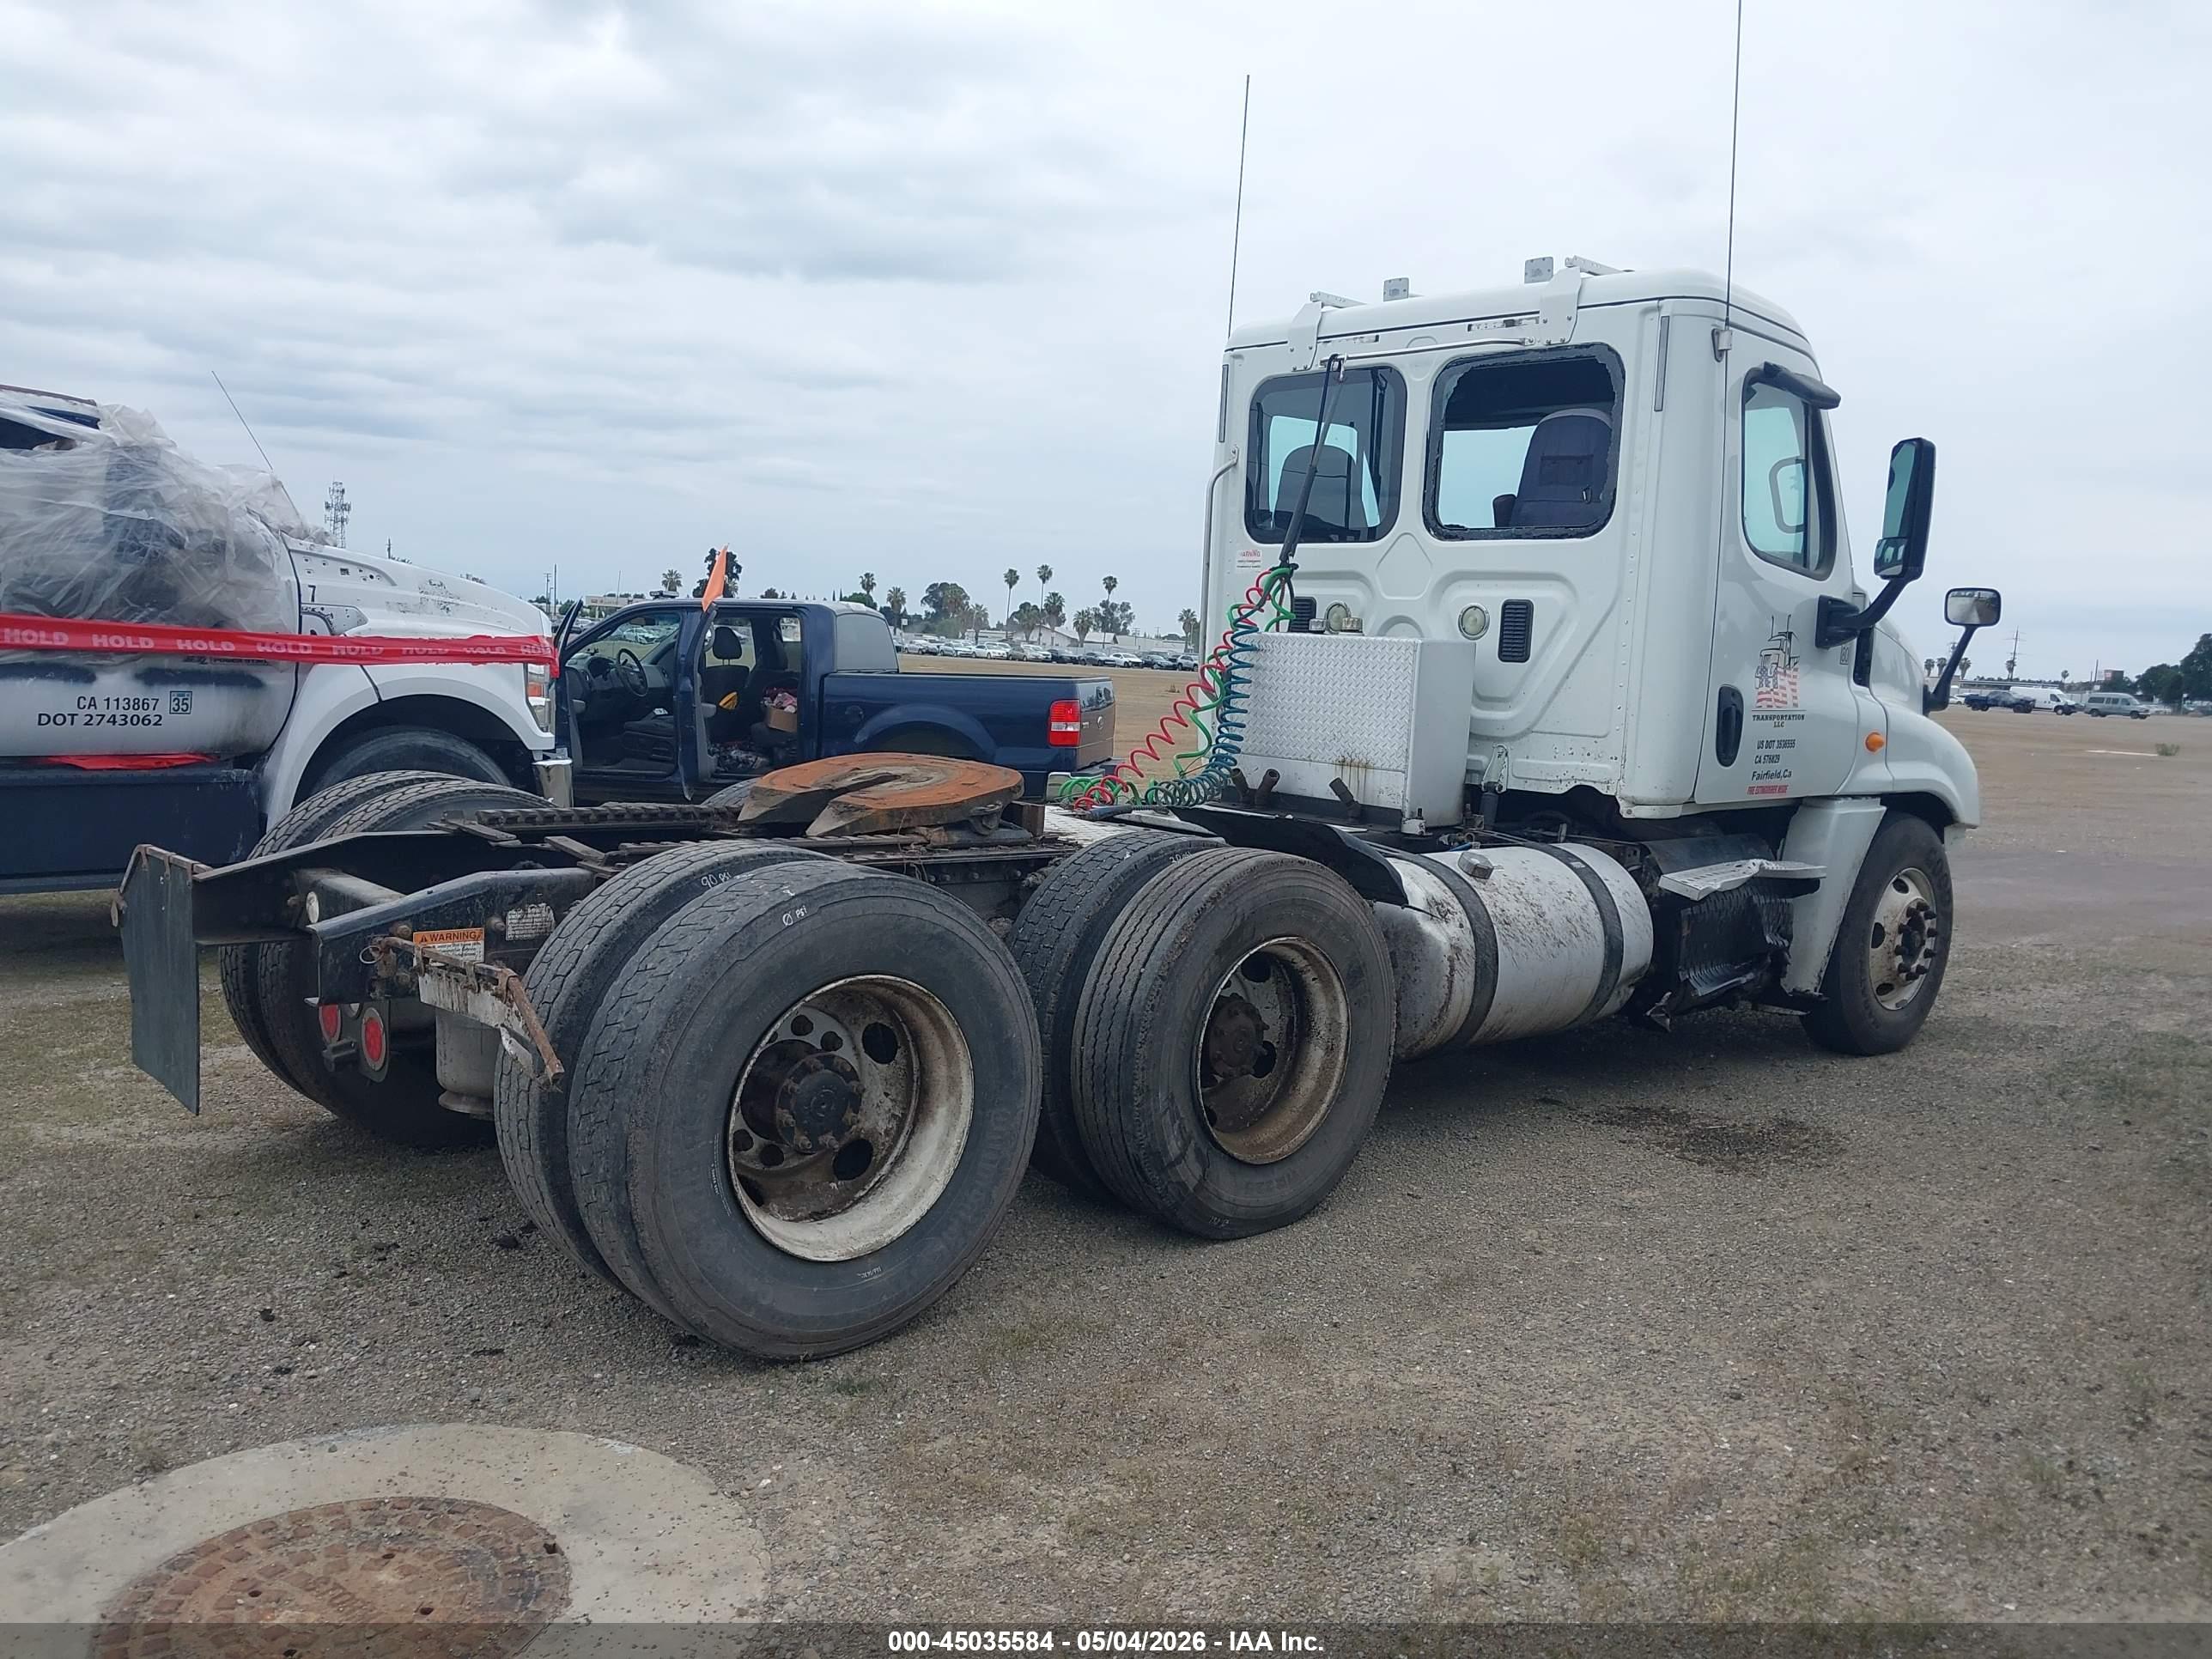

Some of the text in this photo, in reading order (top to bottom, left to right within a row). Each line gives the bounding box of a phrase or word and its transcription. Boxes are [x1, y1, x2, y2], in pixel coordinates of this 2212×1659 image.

[307, 585, 317, 603] 7
[3, 628, 70, 646] HOLD
[91, 634, 155, 649] HOLD
[175, 639, 236, 651] HOLD
[76, 696, 160, 711] CA 113867
[172, 697, 189, 713] 35
[37, 713, 163, 726] DOT 2743062
[1756, 739, 1765, 750] US
[1765, 739, 1776, 750] DOT
[1754, 755, 1762, 764] CA
[701, 873, 718, 888] 90
[429, 931, 477, 942] WARNING
